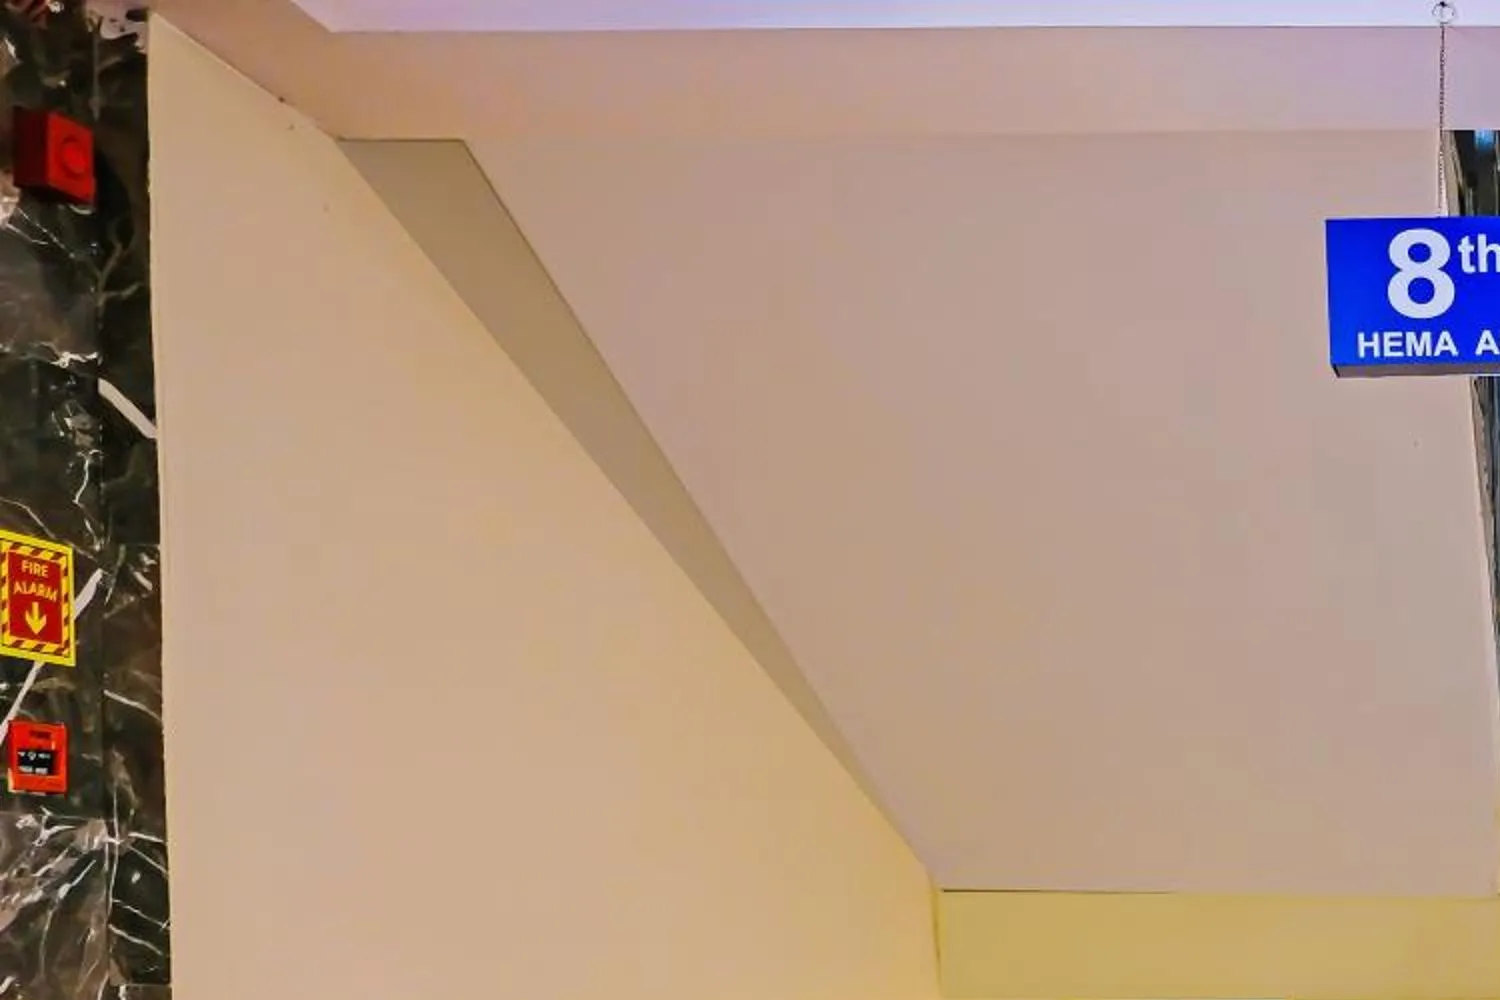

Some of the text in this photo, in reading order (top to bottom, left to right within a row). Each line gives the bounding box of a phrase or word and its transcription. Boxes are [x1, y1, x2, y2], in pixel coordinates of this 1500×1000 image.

[1358, 331, 1459, 358] HEMA
[21, 561, 49, 578] FIRE
[14, 581, 58, 602] ALARM
